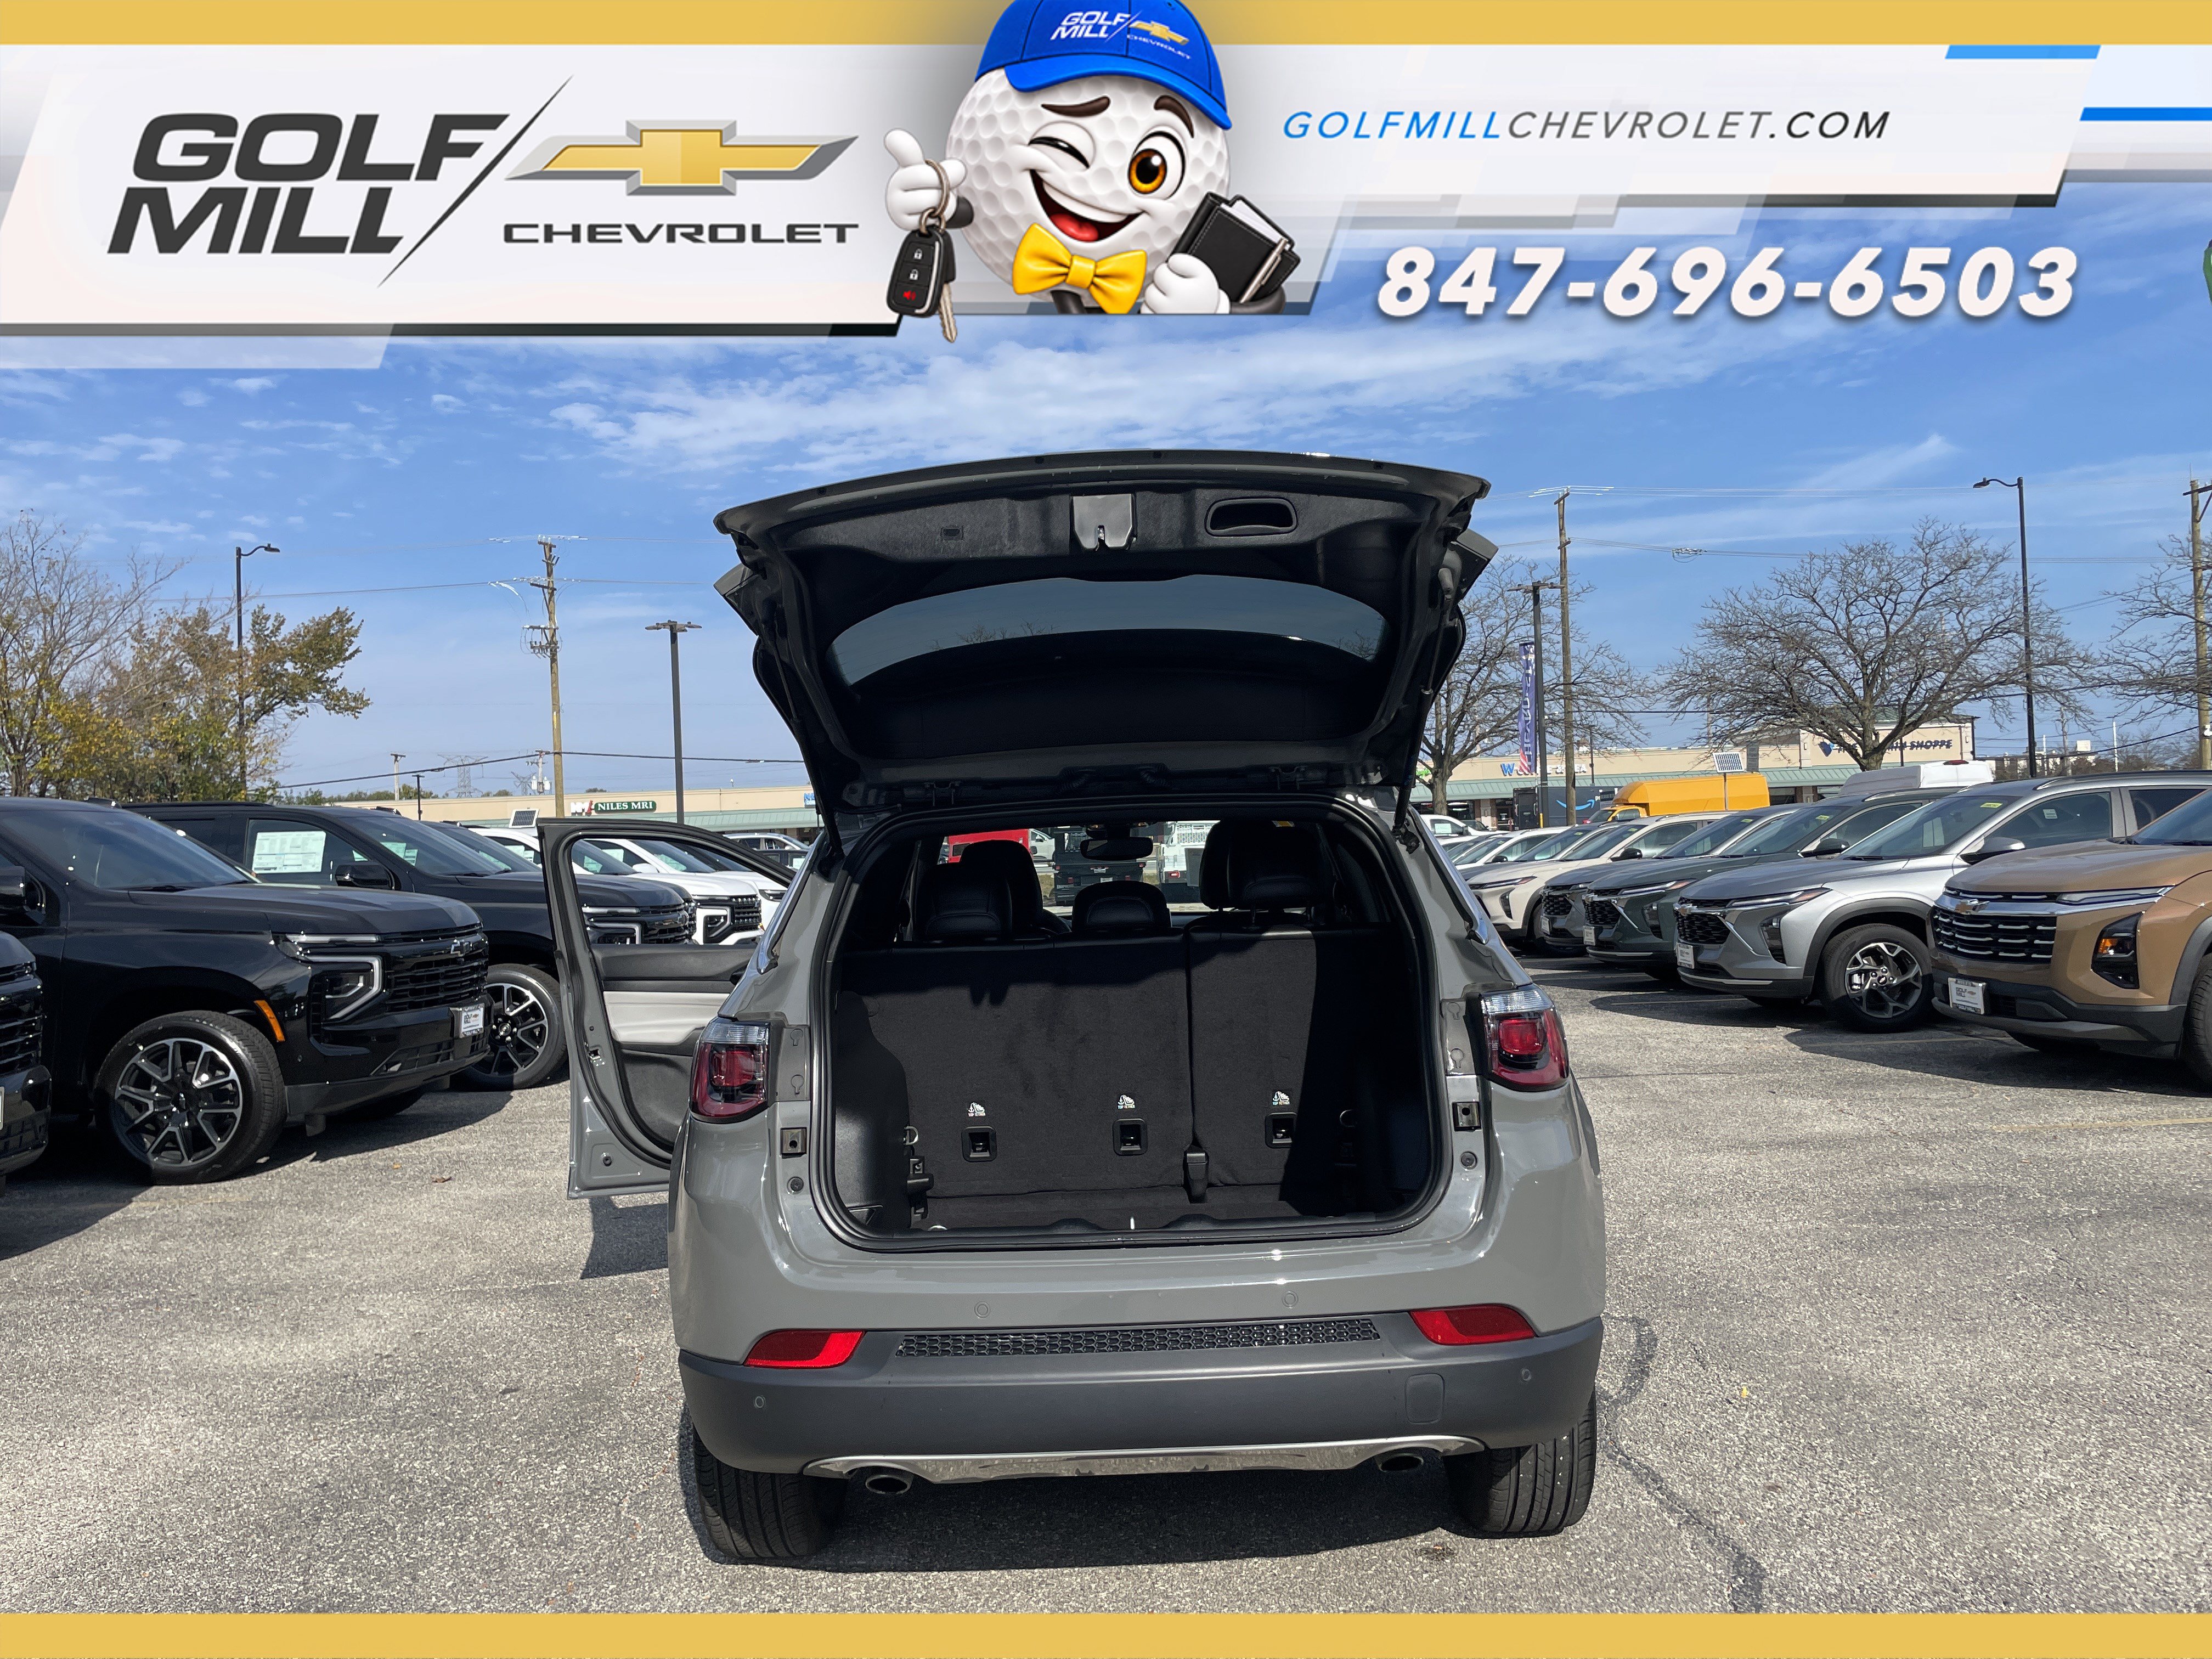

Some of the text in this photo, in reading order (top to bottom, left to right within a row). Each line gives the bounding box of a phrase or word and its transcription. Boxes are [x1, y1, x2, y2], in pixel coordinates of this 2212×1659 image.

[1909, 739, 1953, 750] SHOPPE
[597, 802, 629, 811] NILES
[631, 801, 653, 810] MRI
